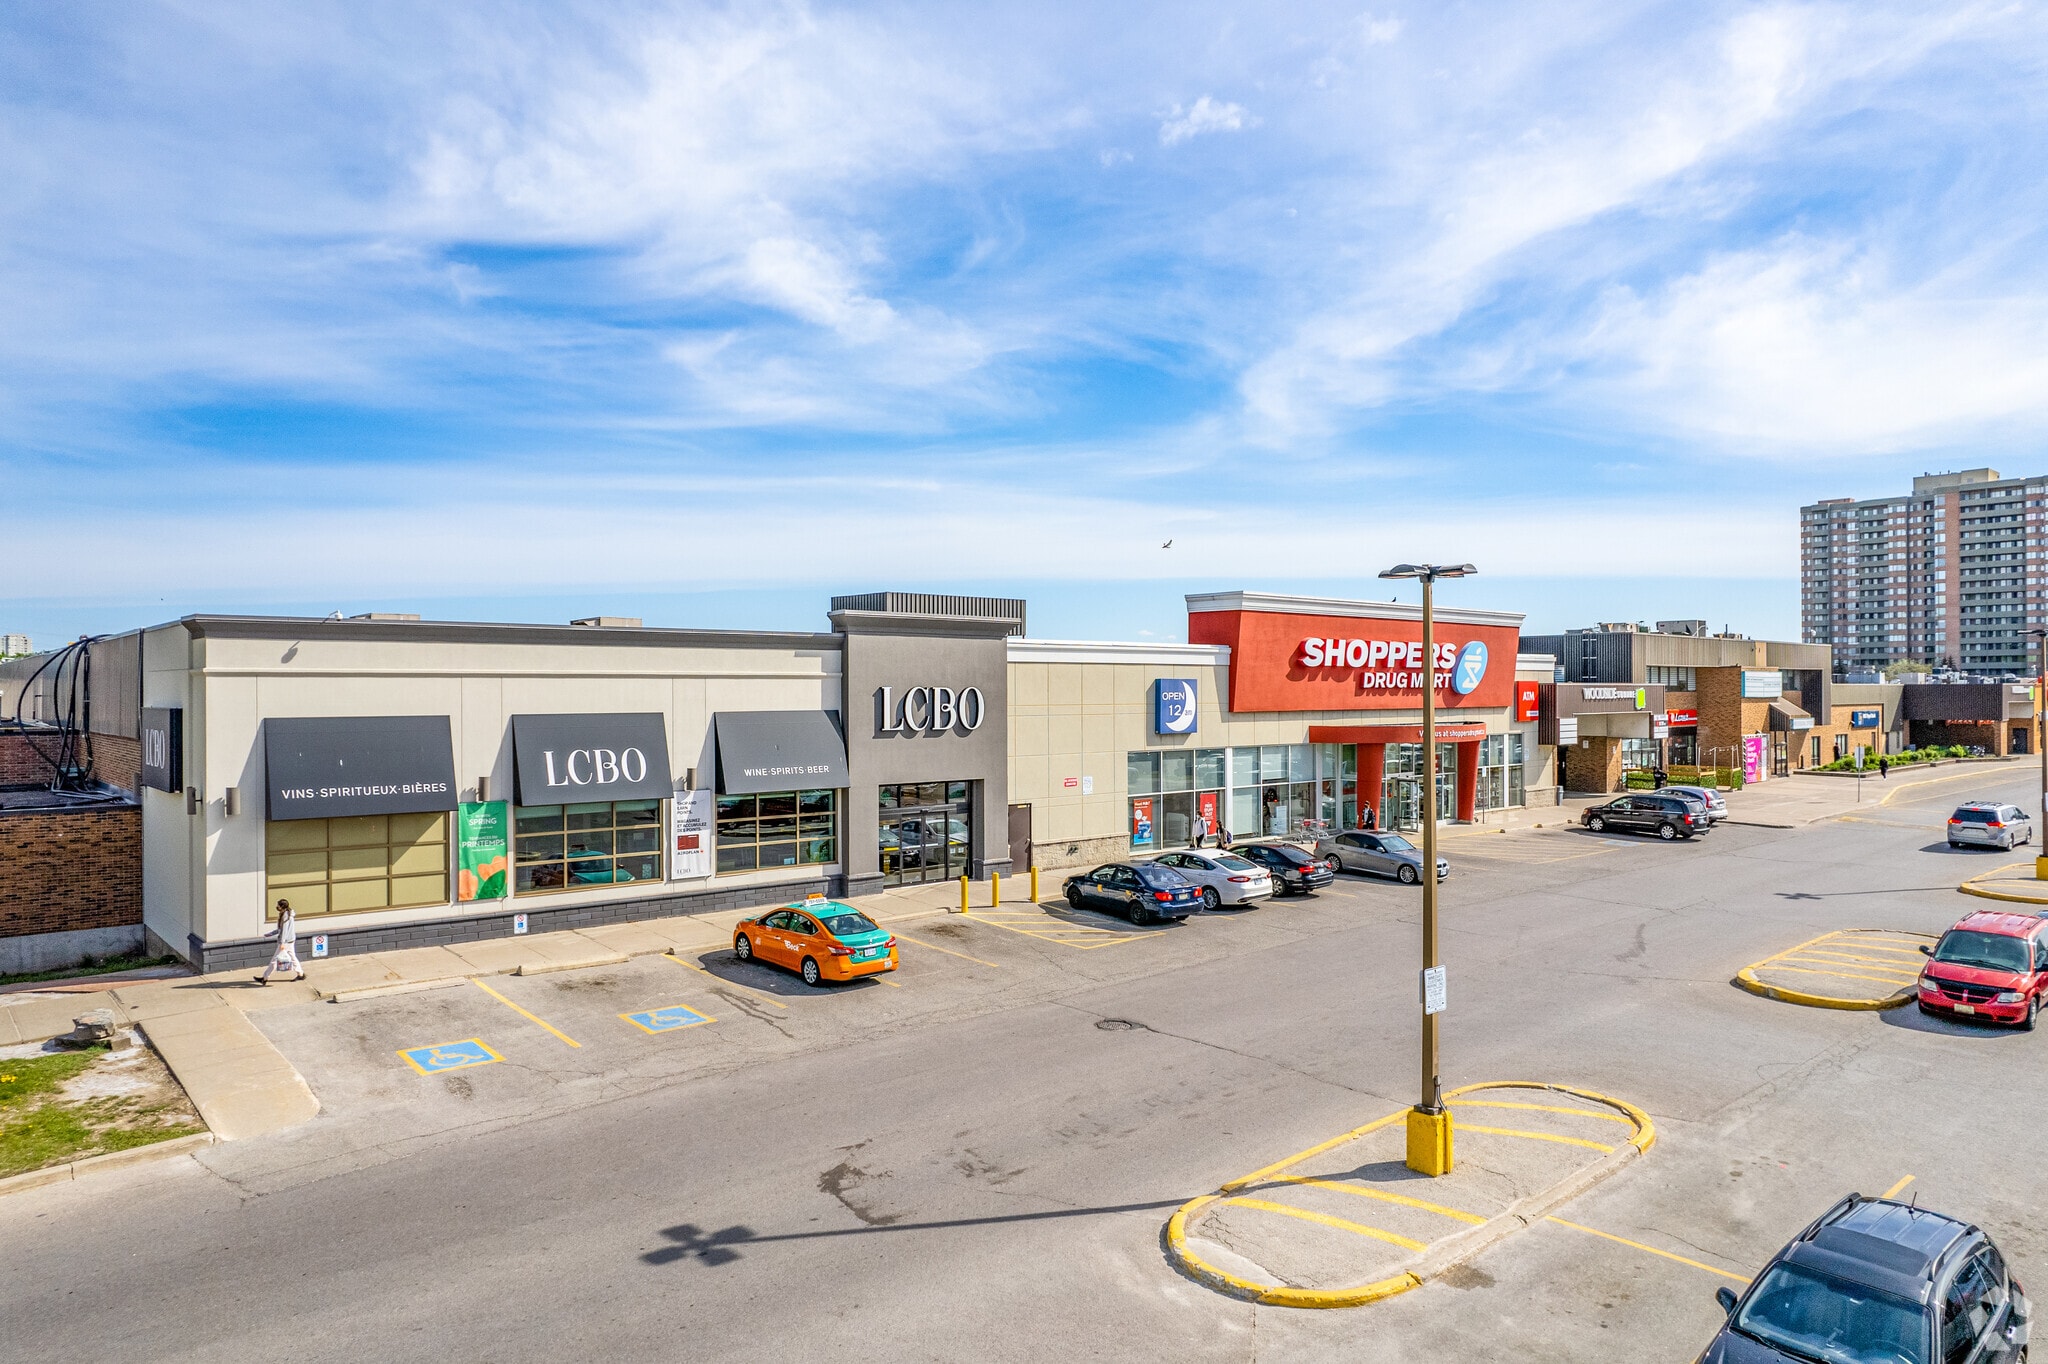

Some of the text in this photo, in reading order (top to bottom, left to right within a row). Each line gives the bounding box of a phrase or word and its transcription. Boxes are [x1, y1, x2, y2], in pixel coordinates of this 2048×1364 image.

[1363, 671, 1452, 689] DRUG MRT
[1162, 692, 1185, 701] OPEN
[1523, 691, 1535, 701] ATM
[881, 686, 985, 732] LCBO
[1168, 704, 1182, 716] 12
[145, 728, 166, 769] LCBO
[543, 747, 648, 787] LCBO
[469, 817, 497, 825] SPRING
[461, 839, 505, 849] PRINTEMPS
